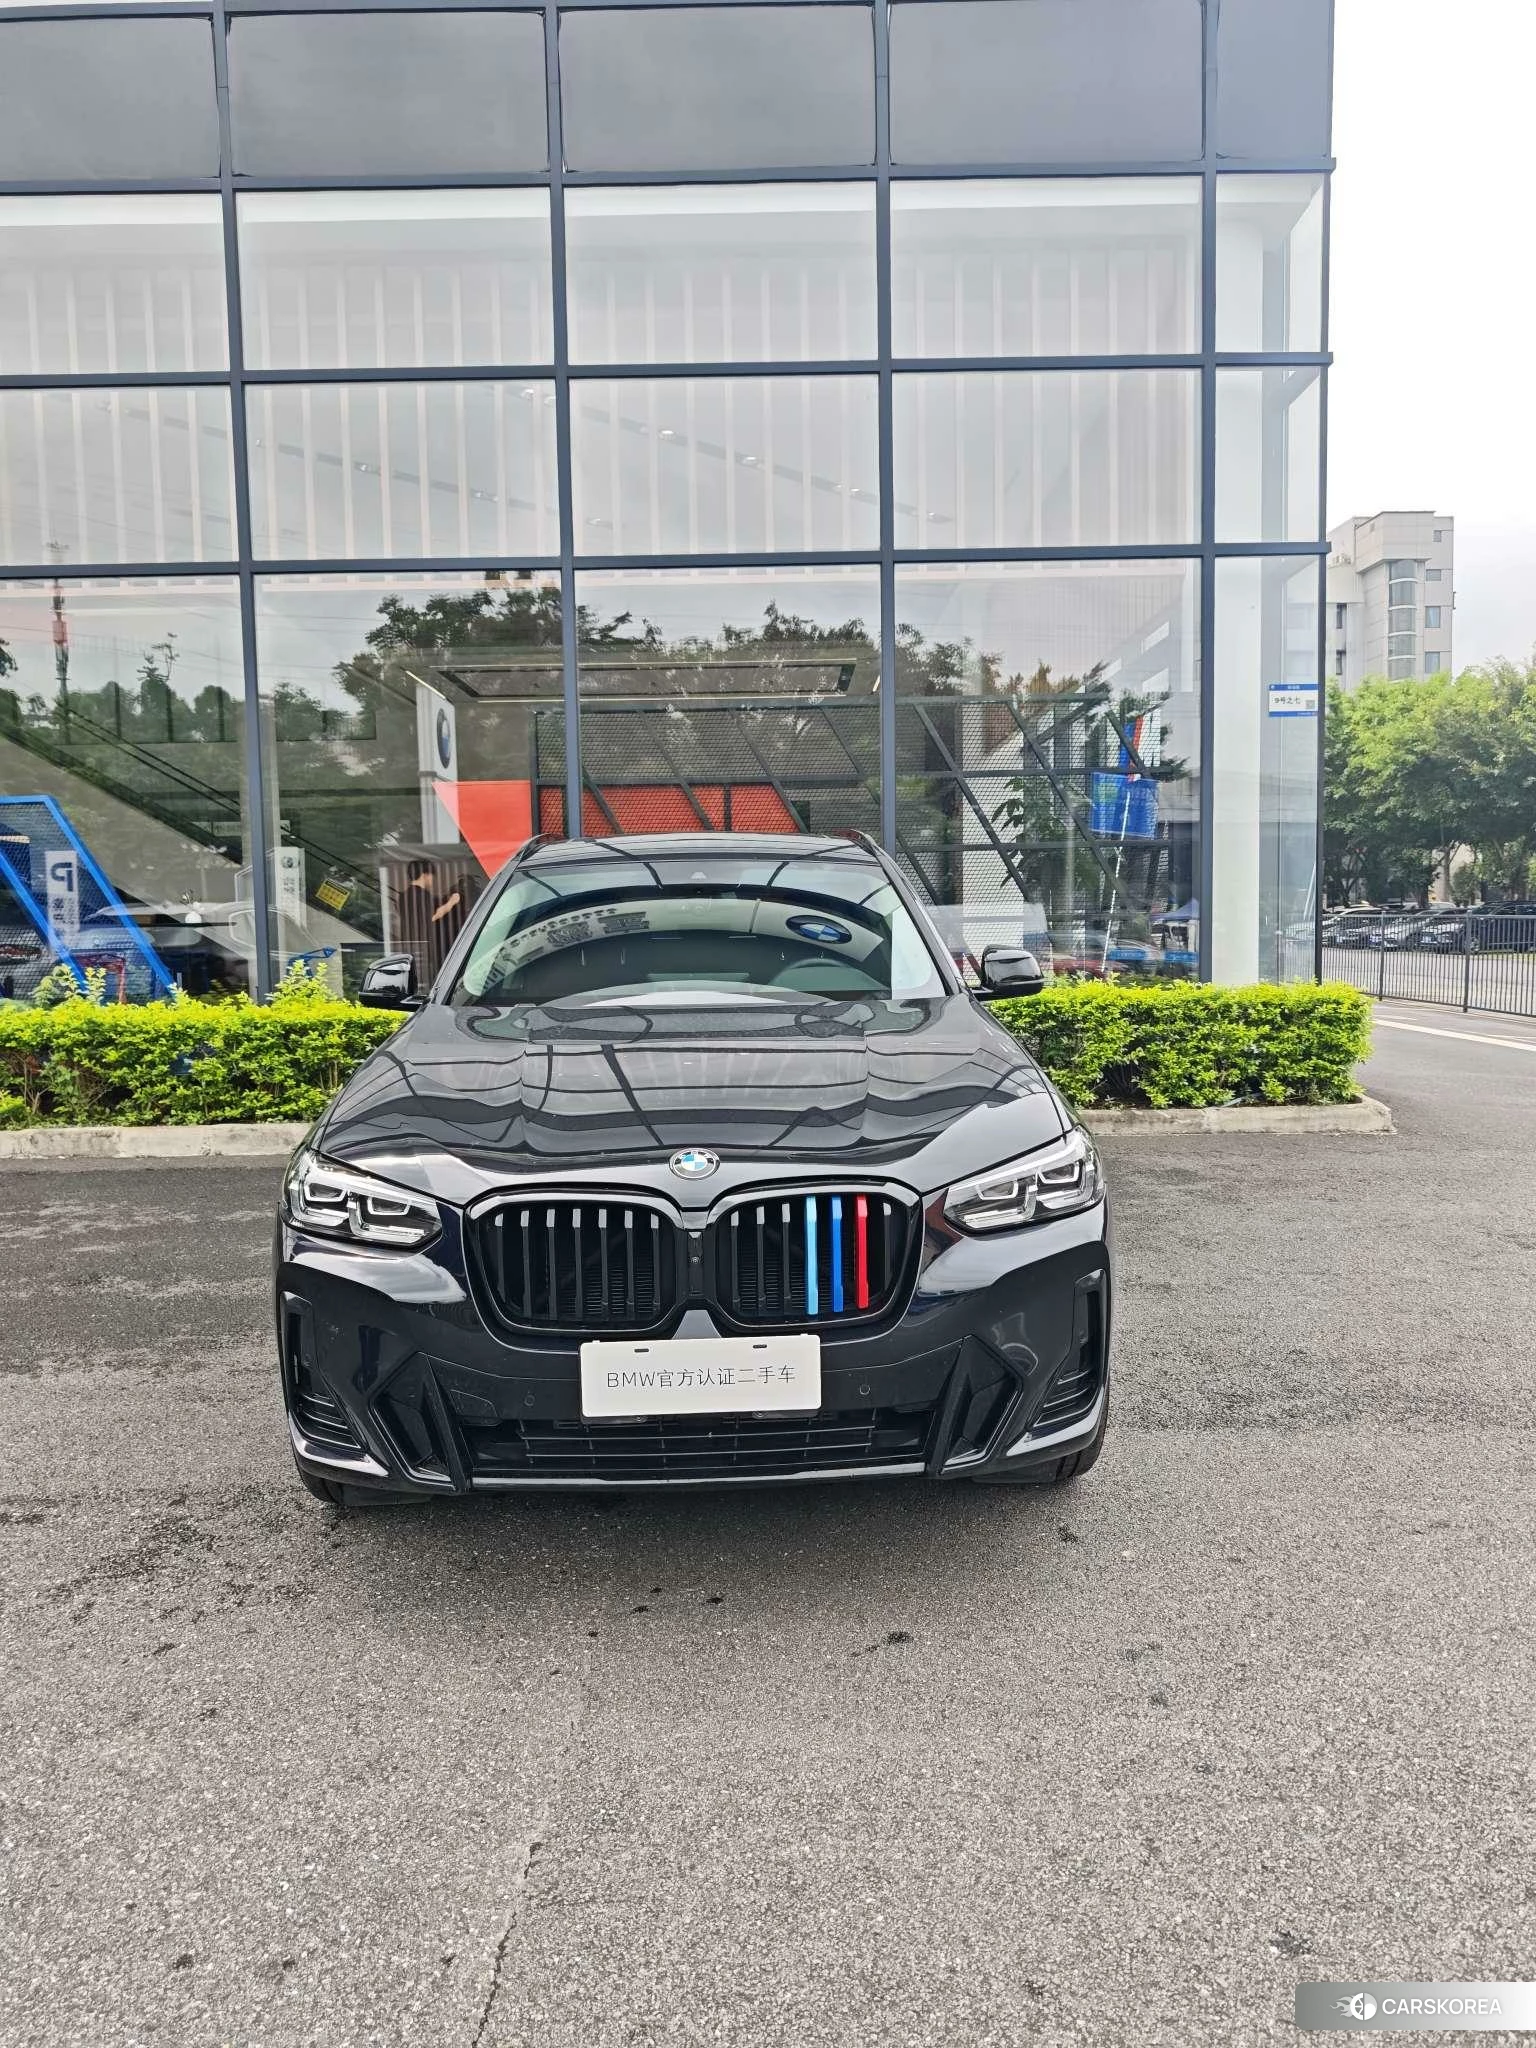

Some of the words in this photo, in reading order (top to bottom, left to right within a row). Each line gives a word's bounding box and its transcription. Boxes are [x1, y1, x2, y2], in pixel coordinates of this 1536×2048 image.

[607, 1364, 796, 1388] BMW官方认证二手车
